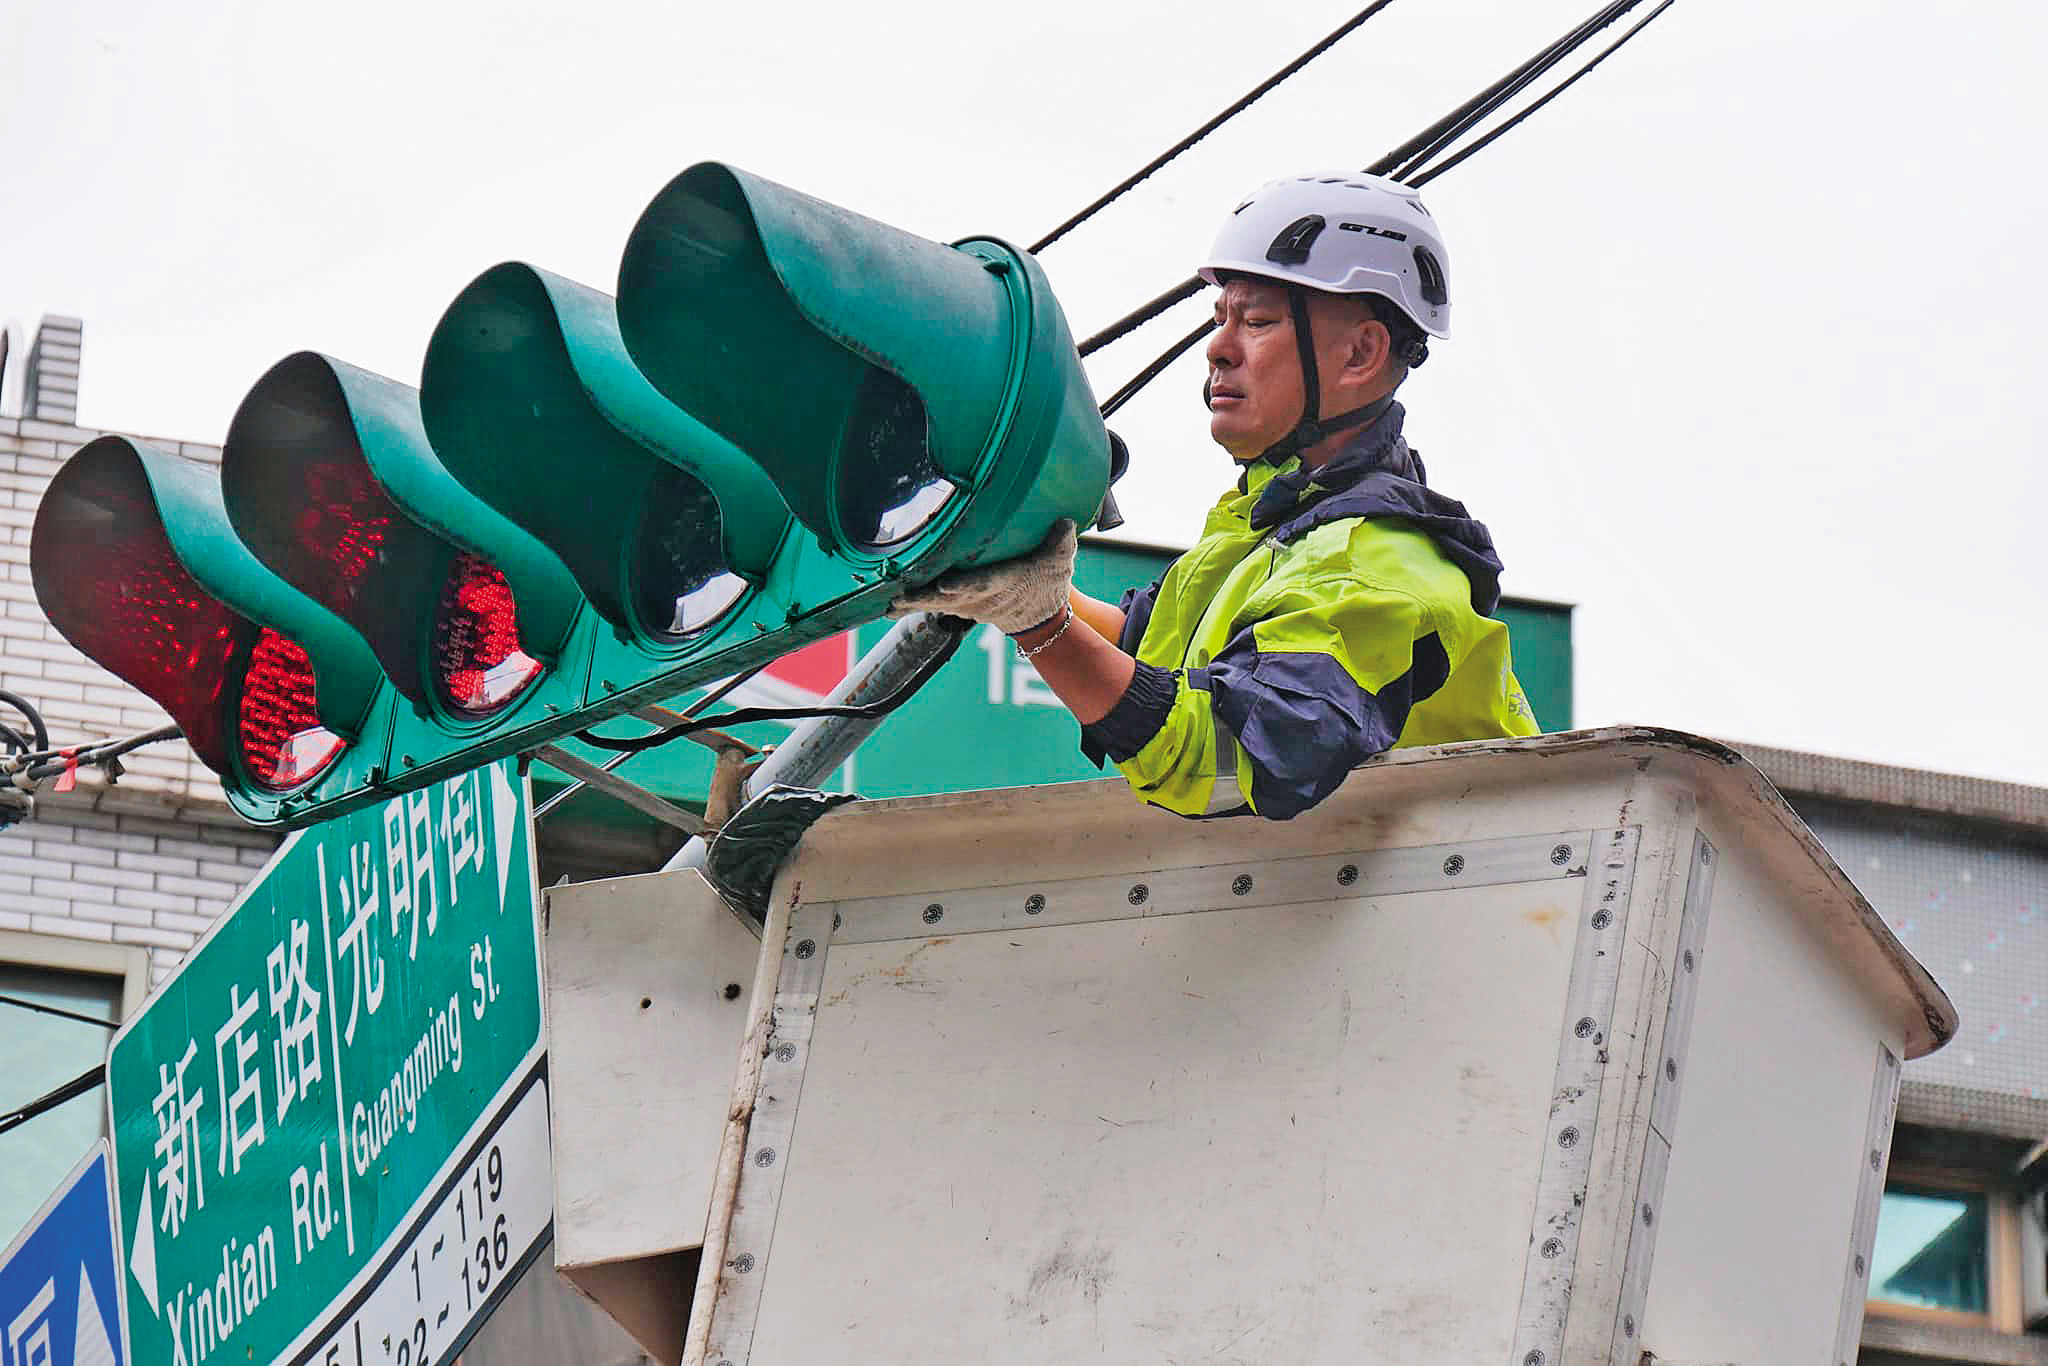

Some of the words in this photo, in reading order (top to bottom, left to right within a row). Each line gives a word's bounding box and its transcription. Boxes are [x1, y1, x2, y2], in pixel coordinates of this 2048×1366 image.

[152, 918, 322, 1239] 新店路
[352, 991, 463, 1176] Guangming
[470, 933, 500, 1021] St.
[166, 1225, 277, 1366] Xindian
[290, 1140, 340, 1265] Rd.
